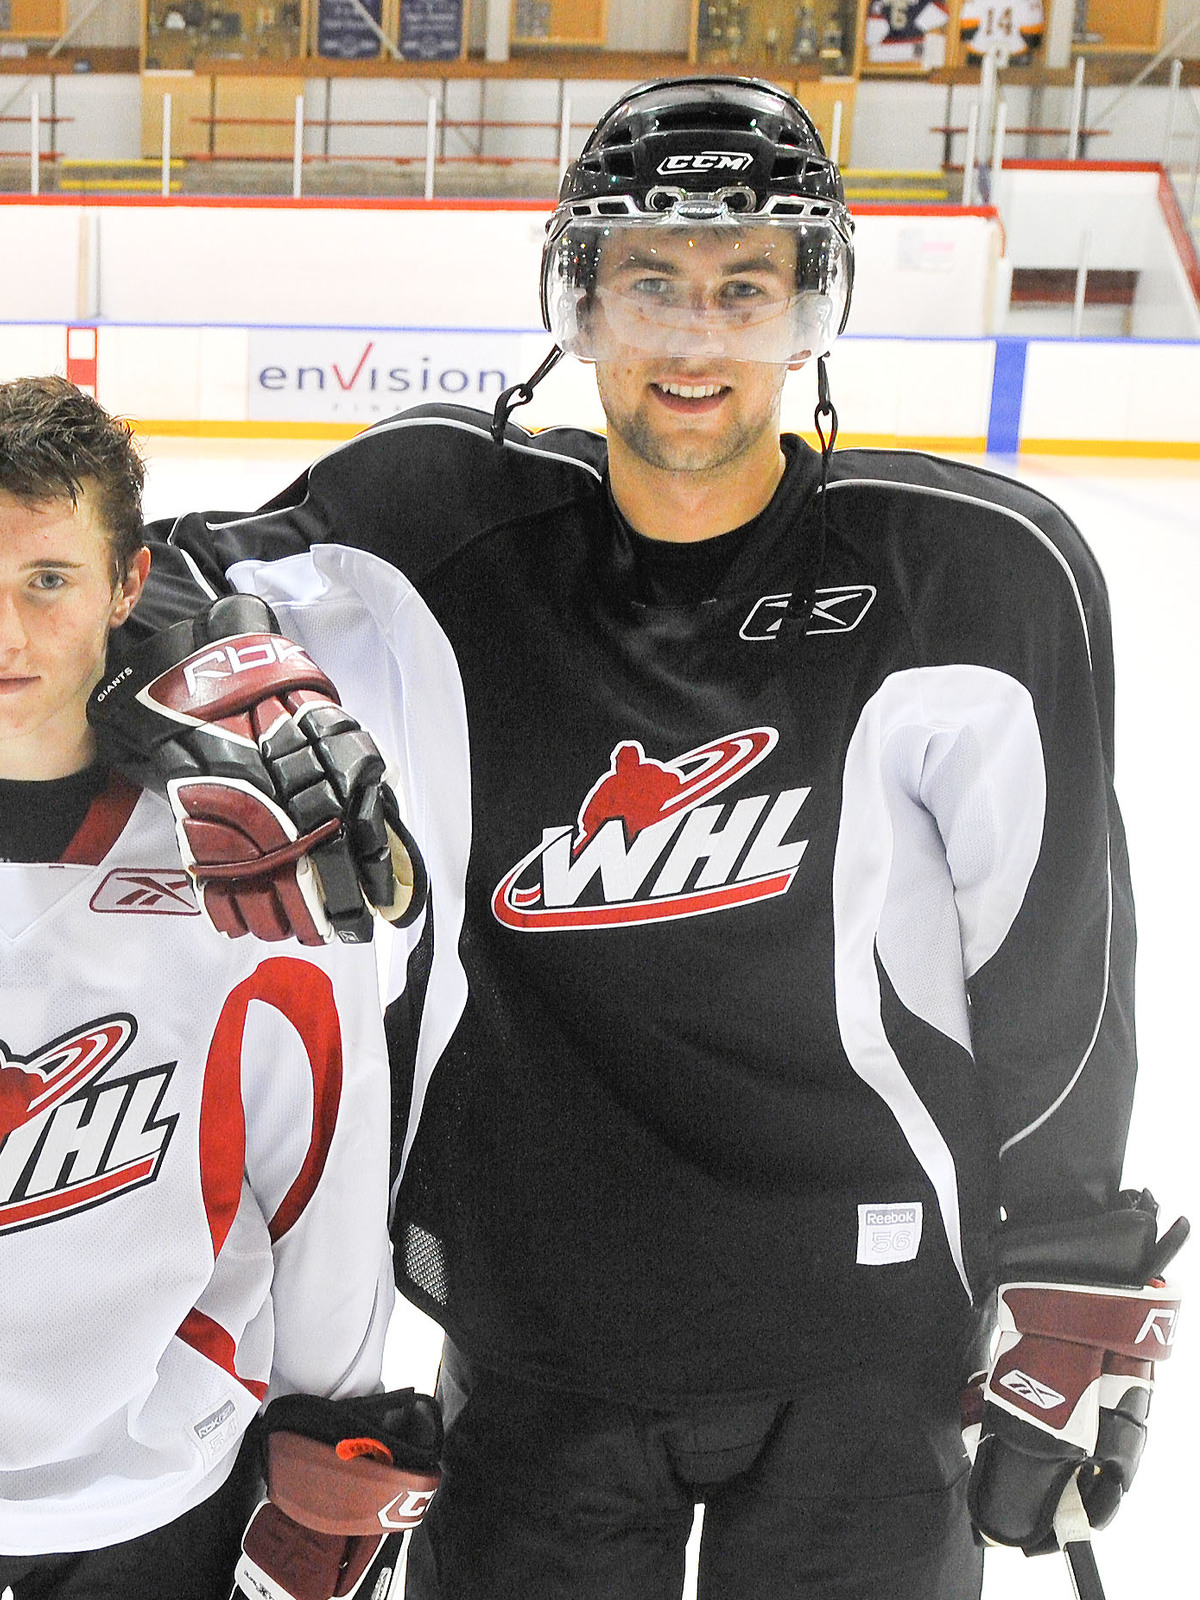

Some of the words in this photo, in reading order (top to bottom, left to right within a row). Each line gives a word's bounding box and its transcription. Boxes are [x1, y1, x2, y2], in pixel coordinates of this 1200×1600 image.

[986, 7, 1013, 36] 14
[666, 155, 748, 171] CCM
[96, 666, 133, 703] GIANTS
[542, 786, 812, 907] WHL
[867, 1210, 914, 1225] Reebok
[871, 1230, 911, 1253] 56
